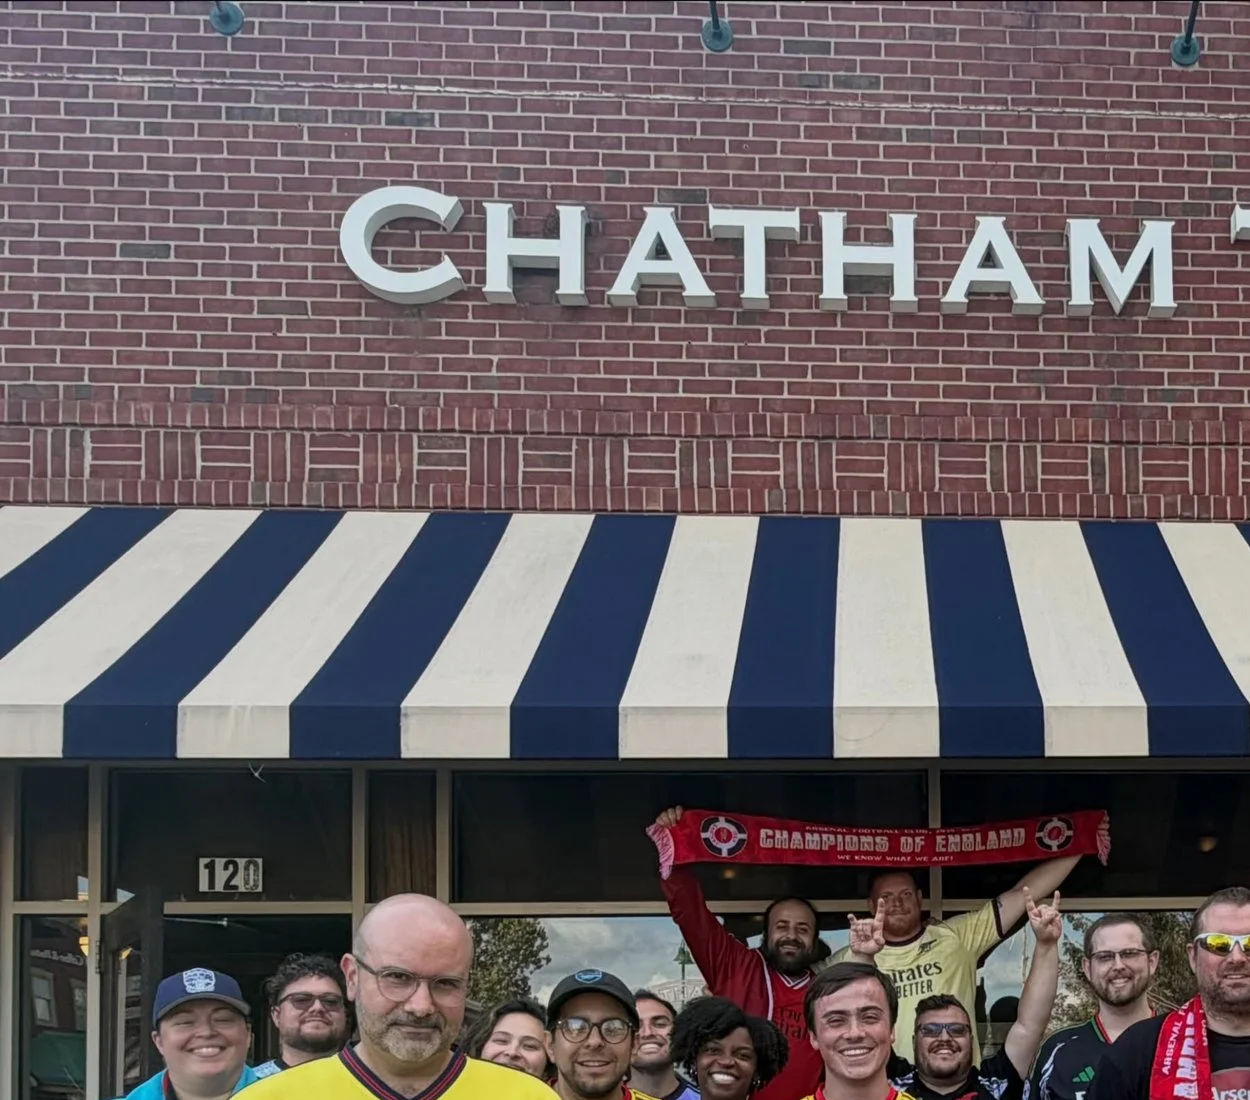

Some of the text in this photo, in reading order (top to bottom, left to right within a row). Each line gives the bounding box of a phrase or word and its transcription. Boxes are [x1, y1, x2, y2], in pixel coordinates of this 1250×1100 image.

[340, 185, 1177, 318] CHATHAM
[759, 828, 890, 852] CHAMPIONS
[900, 836, 926, 853] OF
[203, 858, 262, 891] 120
[891, 961, 943, 984] irates
[1162, 1020, 1183, 1075] ARSENAL
